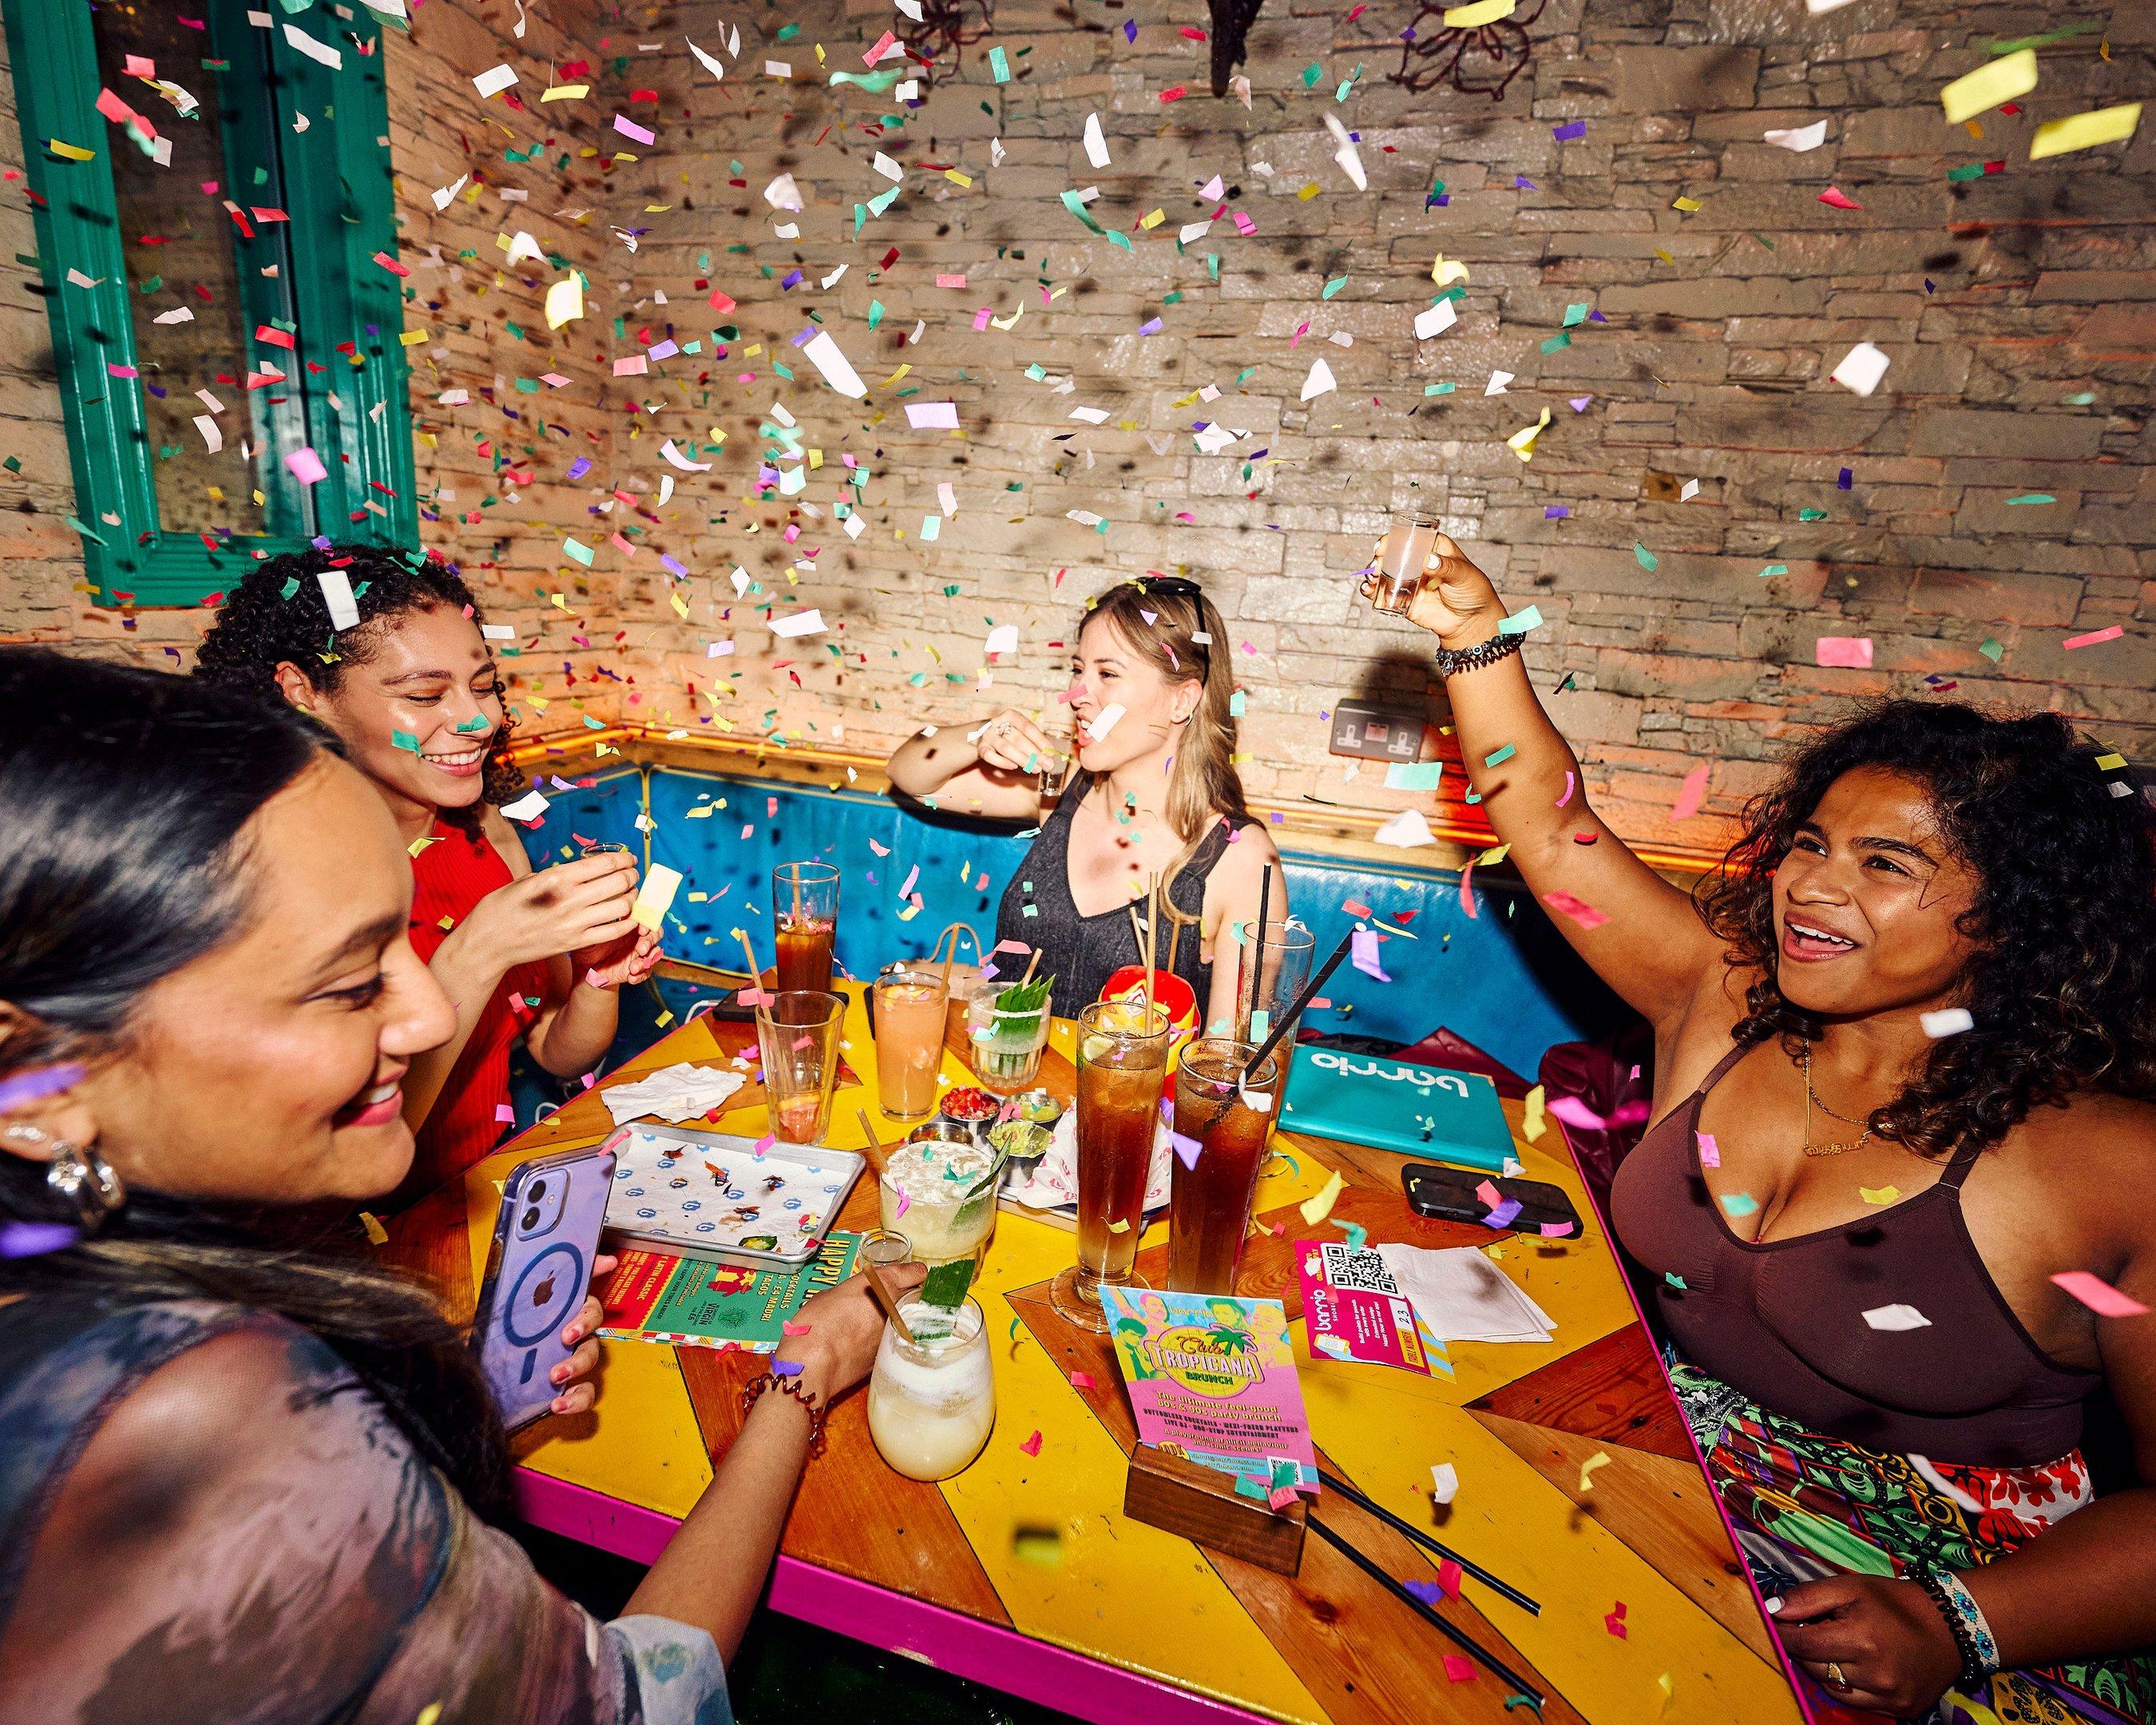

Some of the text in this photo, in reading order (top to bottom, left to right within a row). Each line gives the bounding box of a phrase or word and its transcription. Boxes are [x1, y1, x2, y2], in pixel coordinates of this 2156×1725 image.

[1310, 1052, 1469, 1098] barrio
[651, 1260, 667, 1277] LATIN
[810, 1239, 851, 1285] HAPPY
[636, 1278, 656, 1300] CLASSIC
[757, 1274, 774, 1295] TACOS
[771, 1285, 783, 1295] £4
[699, 1303, 717, 1325] VIRGIN
[1310, 1289, 1332, 1331] barrio
[1397, 1311, 1410, 1324] 23
[1176, 1336, 1224, 1354] Club
[1401, 1330, 1419, 1363] TABLE NUMBER
[1152, 1345, 1257, 1379] TROPICANA
[1185, 1370, 1234, 1385] BRUNCH
[1156, 1390, 1175, 1401] The
[1178, 1396, 1222, 1409] ultimate
[1143, 1408, 1183, 1420] BOTTOMLESS
[1184, 1415, 1218, 1427] COCKTAILS
[1265, 1425, 1299, 1434] PLATTERS
[1157, 1400, 1282, 1422] 80s & 90s party brunch
[1171, 1430, 1213, 1442] playground
[1226, 1430, 1279, 1439] ENTERTAINMENT
